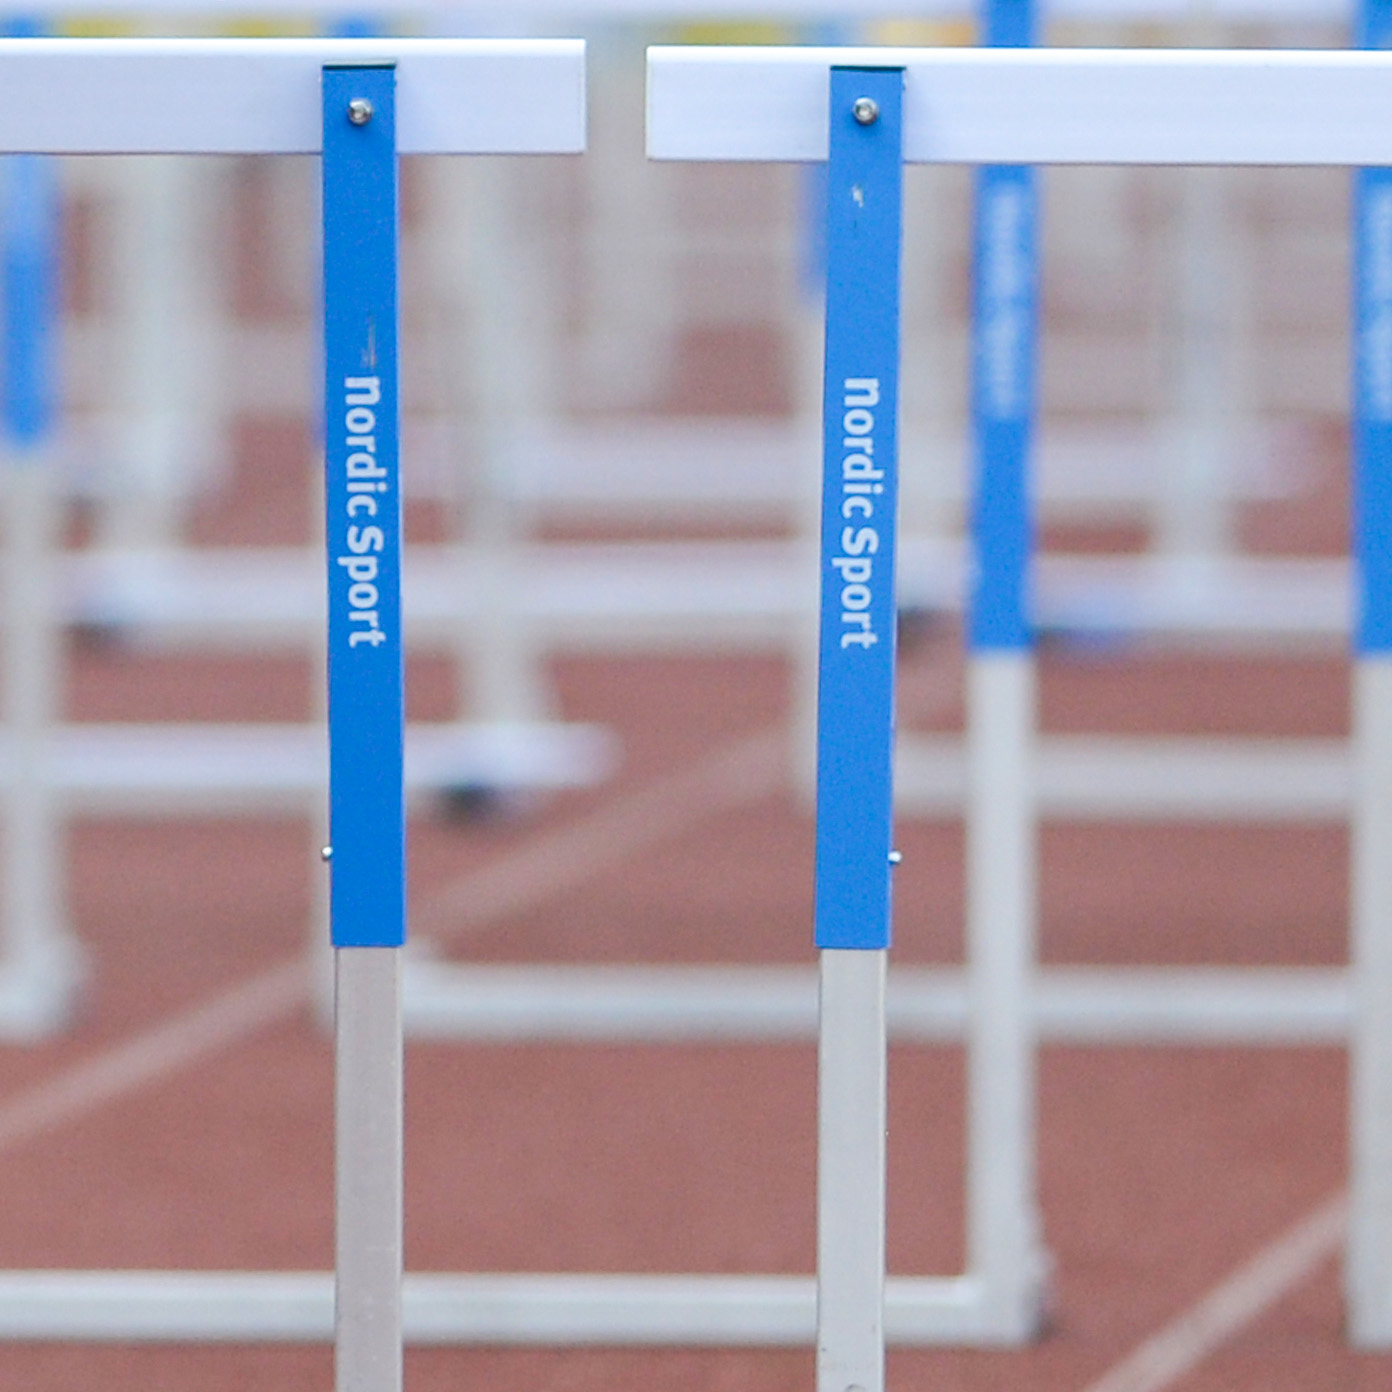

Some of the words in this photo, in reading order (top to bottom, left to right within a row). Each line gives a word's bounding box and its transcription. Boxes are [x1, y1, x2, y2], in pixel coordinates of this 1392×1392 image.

[346, 377, 386, 516] nordic
[843, 379, 884, 517] nordic
[338, 526, 385, 646] Sport
[832, 527, 878, 648] Sport
